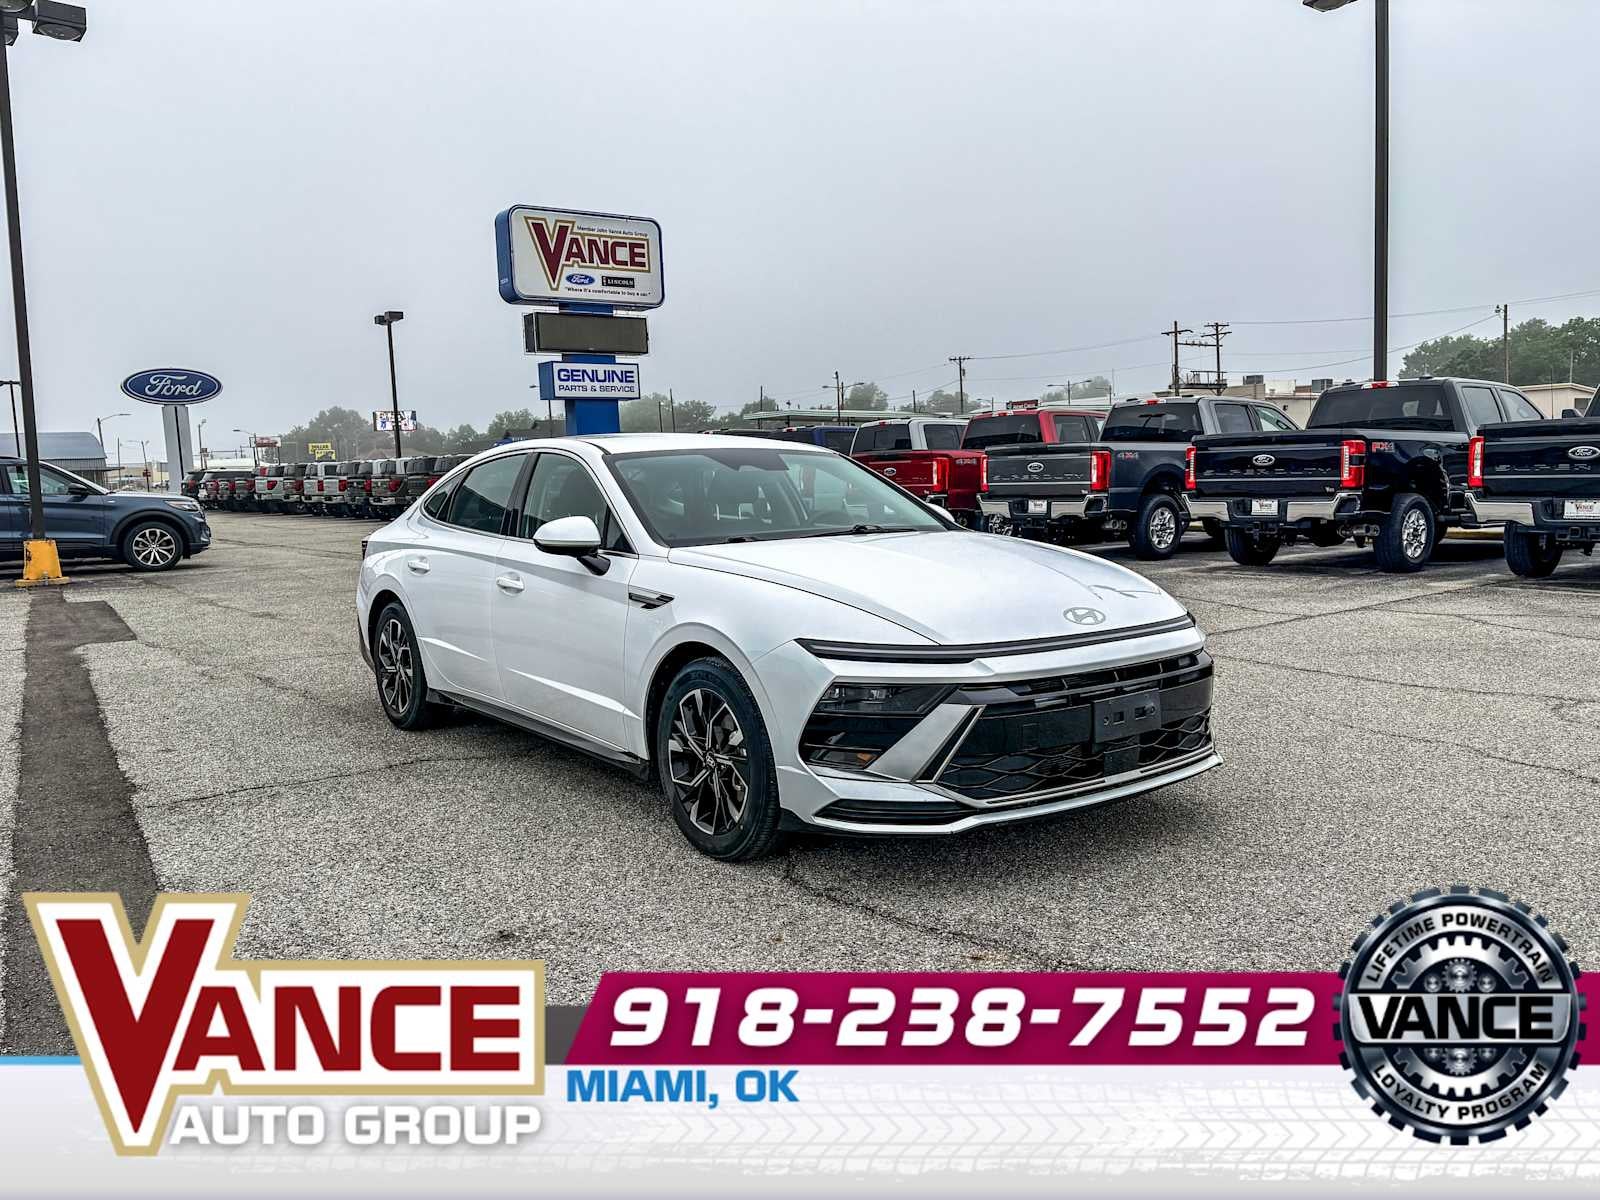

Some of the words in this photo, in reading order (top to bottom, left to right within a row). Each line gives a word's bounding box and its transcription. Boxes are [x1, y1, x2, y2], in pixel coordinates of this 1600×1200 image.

[530, 222, 647, 285] VANCE
[607, 278, 634, 286] LINCOLN
[557, 368, 635, 384] GENUINE
[145, 374, 202, 396] Ford
[558, 384, 588, 392] PARTS
[599, 385, 635, 393] SERVICE
[1371, 441, 1395, 453] FX4
